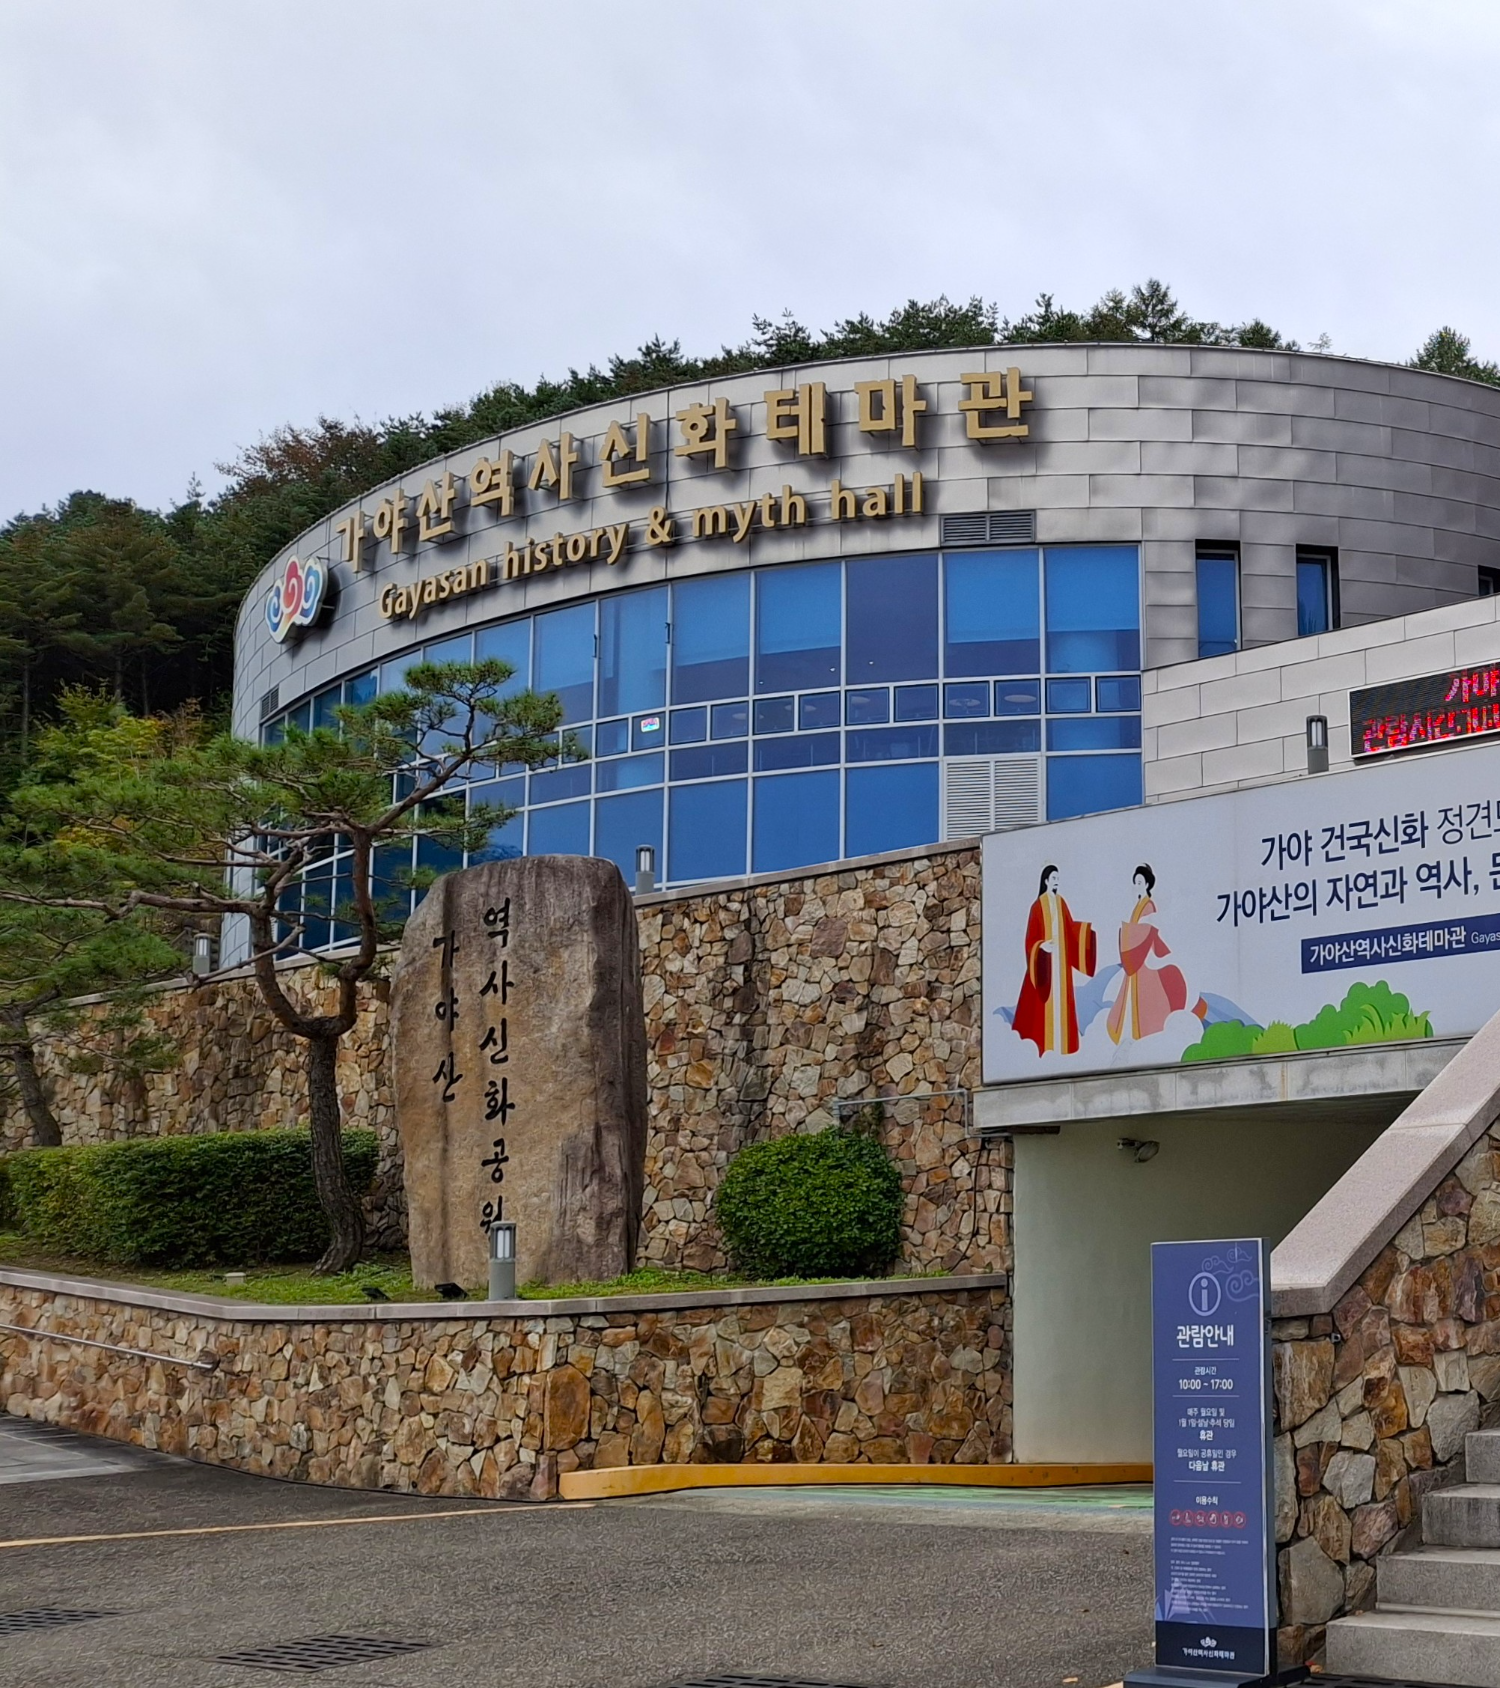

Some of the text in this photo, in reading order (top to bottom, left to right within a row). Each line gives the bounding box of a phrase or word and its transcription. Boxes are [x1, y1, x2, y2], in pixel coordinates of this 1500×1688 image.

[378, 471, 924, 620] Gayasan history & myth hall
[1260, 829, 1313, 870] 가야
[1320, 810, 1429, 863] 건국신화
[1216, 879, 1317, 927] 가야산의
[1325, 866, 1408, 912] 자연과
[1415, 856, 1479, 899] 역사,
[1309, 925, 1467, 965] 가야산역사신화테마관
[432, 929, 463, 1102] 가야산
[1176, 1325, 1235, 1348] 관람안내
[1178, 1378, 1202, 1390] 10:00
[1210, 1378, 1234, 1390] 17:00
[1199, 1429, 1214, 1441] 휴관
[1188, 1460, 1225, 1472] 다음날 휴관
